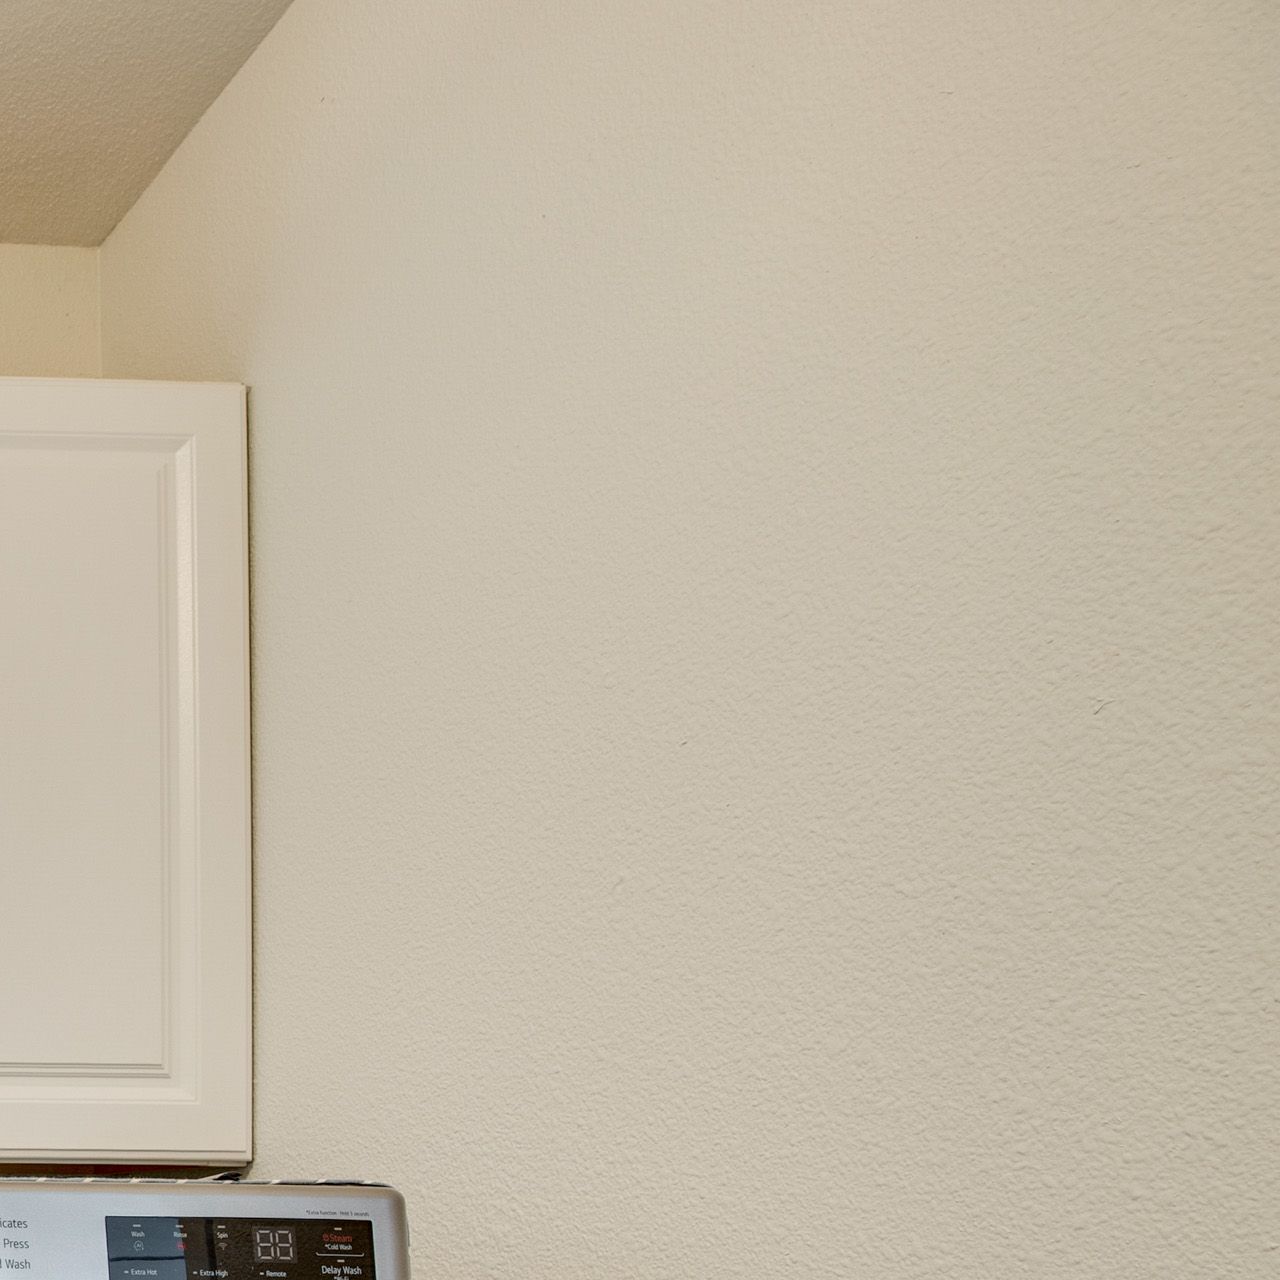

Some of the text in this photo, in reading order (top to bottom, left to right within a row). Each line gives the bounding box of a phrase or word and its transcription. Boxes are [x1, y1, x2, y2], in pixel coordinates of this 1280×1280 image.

[2, 1238, 30, 1249] Press
[5, 1258, 31, 1269] Wash
[216, 1270, 228, 1278] High
[321, 1266, 362, 1276] Delay Wash
